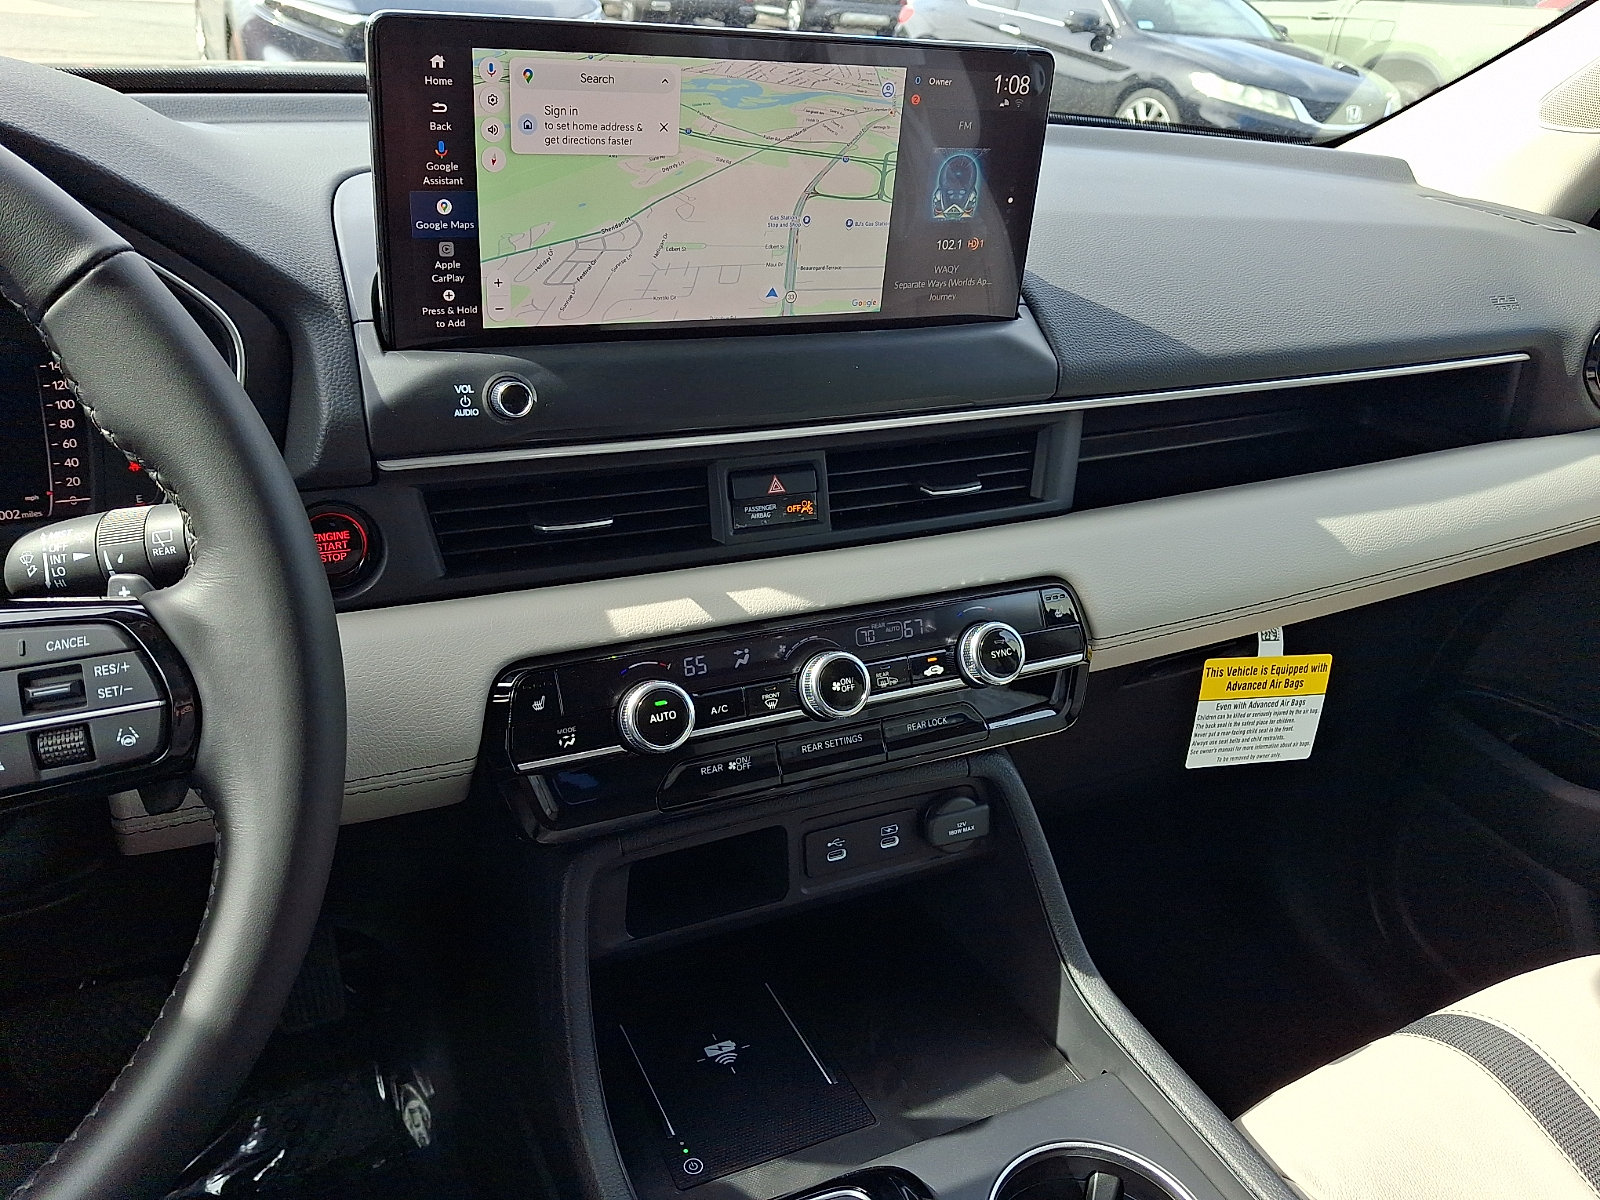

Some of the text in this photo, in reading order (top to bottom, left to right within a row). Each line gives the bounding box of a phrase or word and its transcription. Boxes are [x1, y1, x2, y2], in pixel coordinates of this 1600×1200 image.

[424, 75, 453, 86] Home
[580, 72, 615, 84] Search
[928, 77, 953, 87] Owner
[994, 74, 1031, 95] 1:08
[544, 105, 579, 118] Sign in
[429, 121, 452, 131] Back
[544, 121, 643, 132] to set home address &
[958, 121, 973, 131] FM
[544, 135, 633, 147] get directions faster
[426, 162, 459, 173] Google
[423, 176, 464, 185] Assistant
[415, 220, 475, 231] Google Maps
[936, 239, 962, 250] 102.1
[434, 260, 461, 270] Apple
[934, 264, 960, 275] WAQY
[431, 274, 465, 284] CarPlay
[894, 277, 976, 290] Separate Ways (Worlds
[851, 298, 877, 308] Google
[928, 293, 957, 302] Journey
[422, 305, 478, 316] Press & Hold
[435, 318, 466, 328] to Add
[454, 384, 475, 394] VOL
[54, 400, 76, 410] 100
[454, 408, 480, 418] AUDIO
[59, 419, 75, 429] 80
[62, 439, 77, 448] 60
[64, 458, 79, 467] 40
[66, 477, 81, 487] 20
[135, 494, 143, 503] E
[744, 503, 777, 513] PASSENGER
[786, 504, 802, 513] OFF
[313, 530, 350, 542] ENGINE
[49, 543, 68, 553] OFF
[152, 545, 177, 556] REAR
[316, 540, 348, 551] START
[49, 553, 67, 565] INT
[320, 552, 347, 563] STOP
[51, 566, 66, 578] LO
[53, 579, 67, 588] HI
[903, 618, 924, 638] 67
[860, 629, 875, 643] 70
[46, 635, 90, 652] CANCEL
[990, 648, 1013, 660] SYNC
[93, 661, 131, 677] RES/+
[683, 656, 708, 677] 65
[1205, 662, 1328, 678] This Vehicle is Equipped with
[841, 684, 856, 693] OFF
[1225, 678, 1305, 692] Advanced Air Bags
[761, 691, 780, 700] FRONT
[710, 704, 729, 715] A/C
[1215, 698, 1306, 711] Even with Advanced Air Bags
[649, 710, 677, 724] AUTO
[906, 716, 948, 732] REAR LOCK
[556, 726, 577, 735] MODE
[801, 733, 863, 754] REAR SETTINGS
[700, 763, 724, 776] REAR
[736, 761, 752, 771] OFF
[957, 820, 967, 828] 12V
